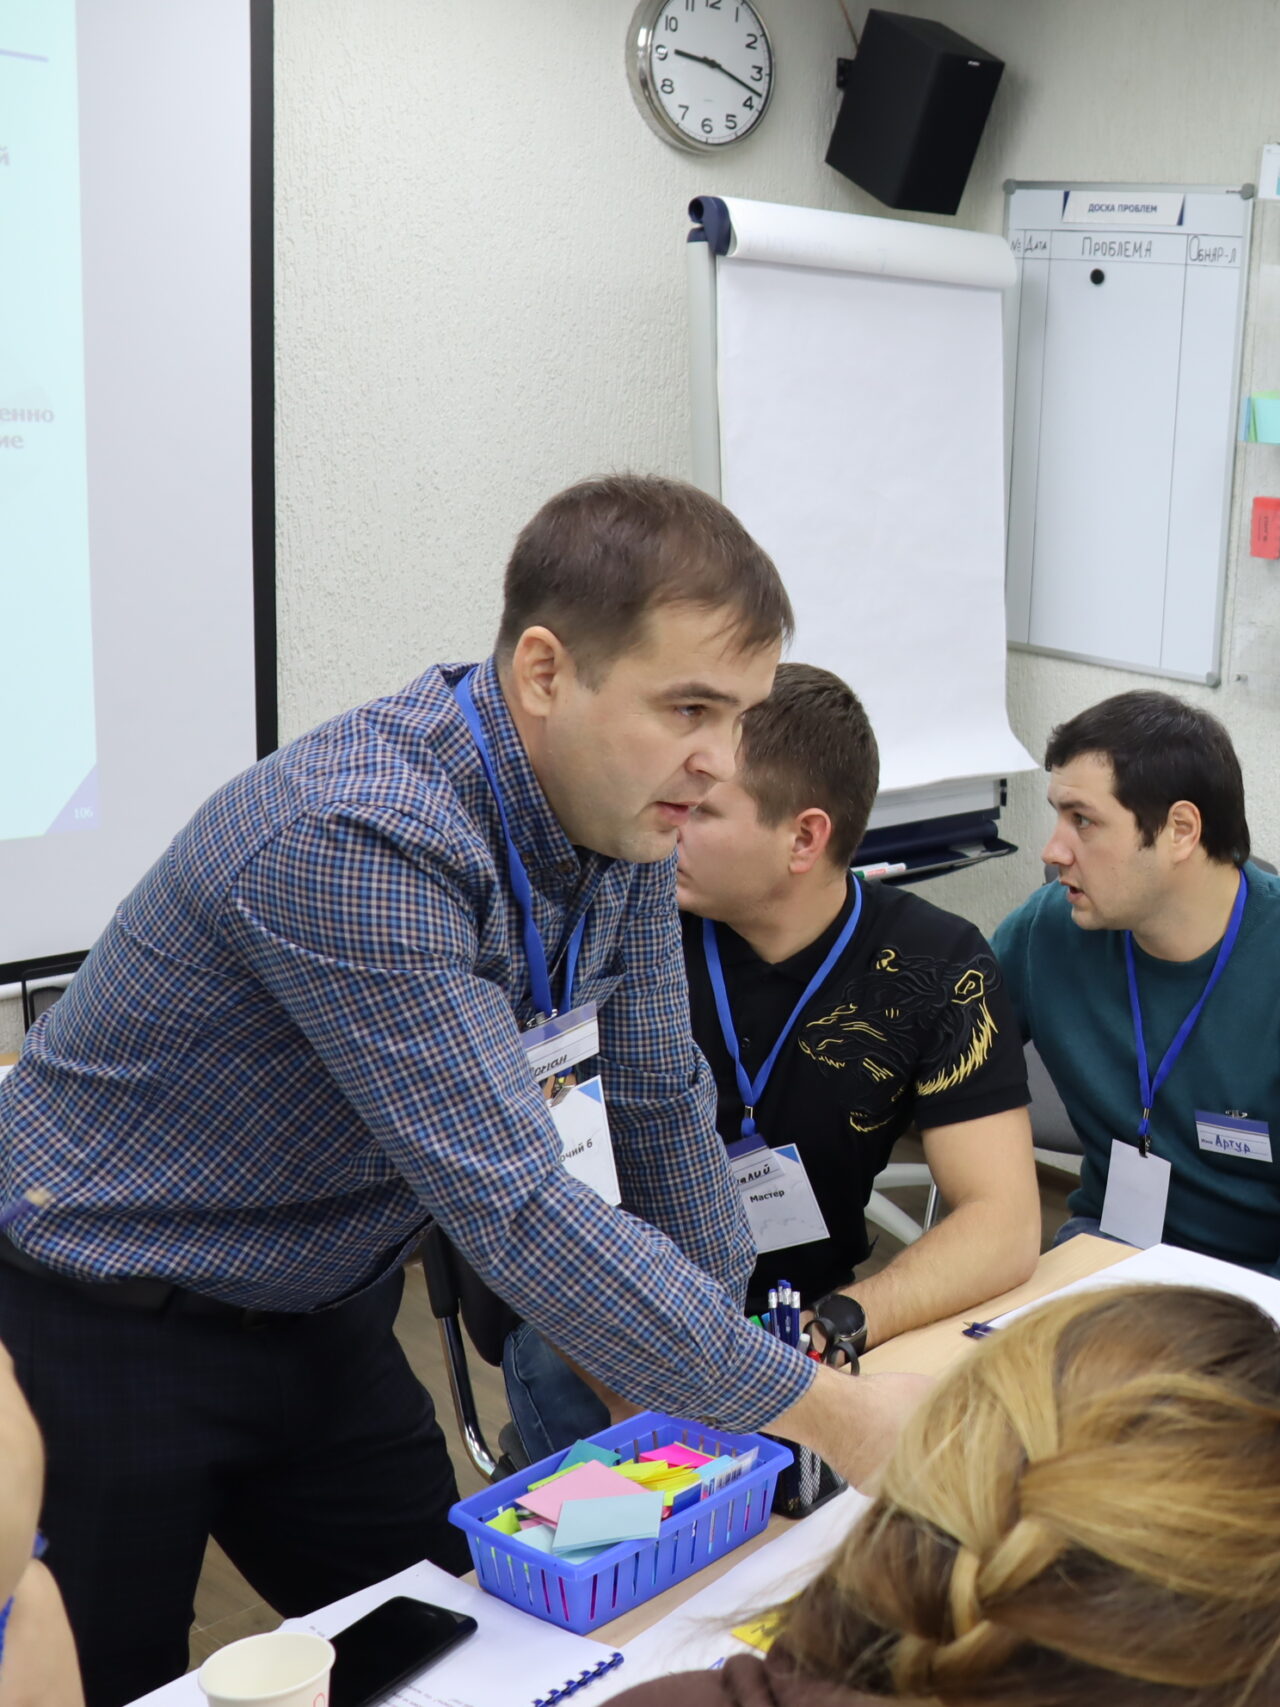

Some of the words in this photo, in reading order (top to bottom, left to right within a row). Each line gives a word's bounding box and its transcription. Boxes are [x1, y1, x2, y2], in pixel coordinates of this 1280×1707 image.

[665, 15, 678, 32] 10
[745, 33, 758, 50] 2
[655, 44, 668, 61] 9
[750, 65, 763, 81] 3
[660, 78, 674, 94] 8
[742, 96, 755, 111] 4
[678, 104, 689, 120] 7
[701, 118, 713, 134] 6
[725, 113, 737, 129] 5
[1088, 204, 1115, 213] ДОСКА
[1118, 203, 1157, 213] ПРОБЛЕМ
[1215, 1134, 1251, 1153] Артур
[749, 1189, 785, 1203] Мастер
